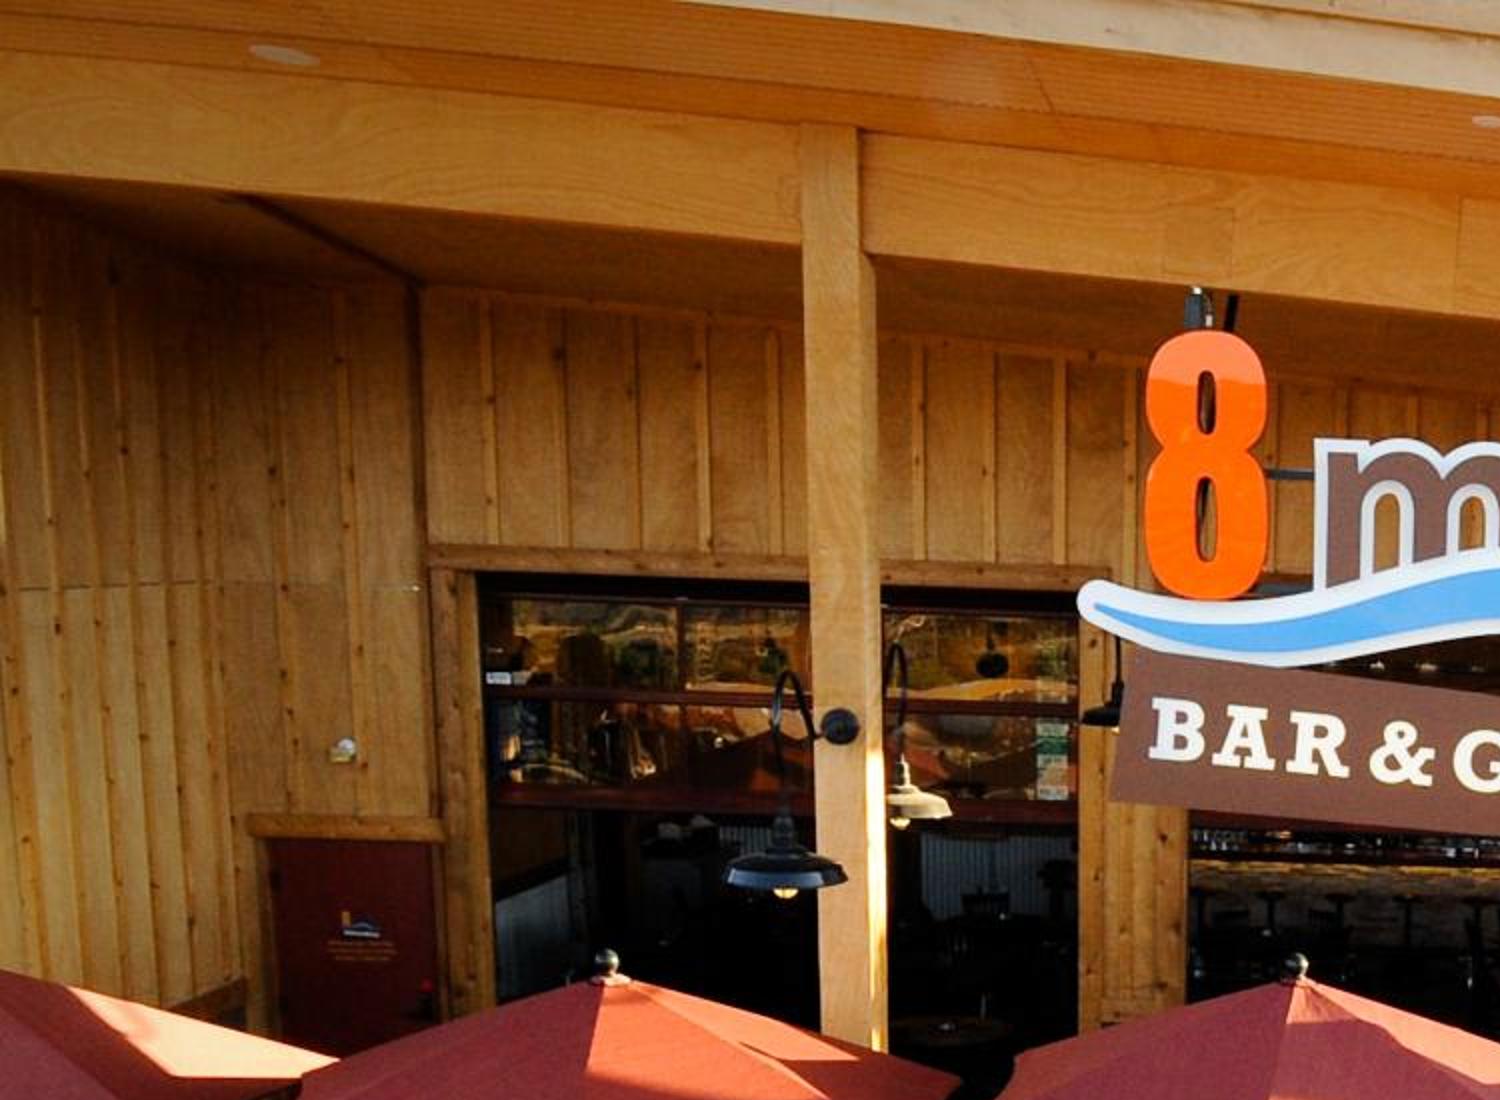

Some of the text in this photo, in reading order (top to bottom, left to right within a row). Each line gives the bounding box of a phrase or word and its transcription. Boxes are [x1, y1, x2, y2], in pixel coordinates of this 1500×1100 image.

[1144, 330, 1268, 600] 8
[1147, 697, 1351, 779] BAR
[1369, 720, 1436, 787] &
